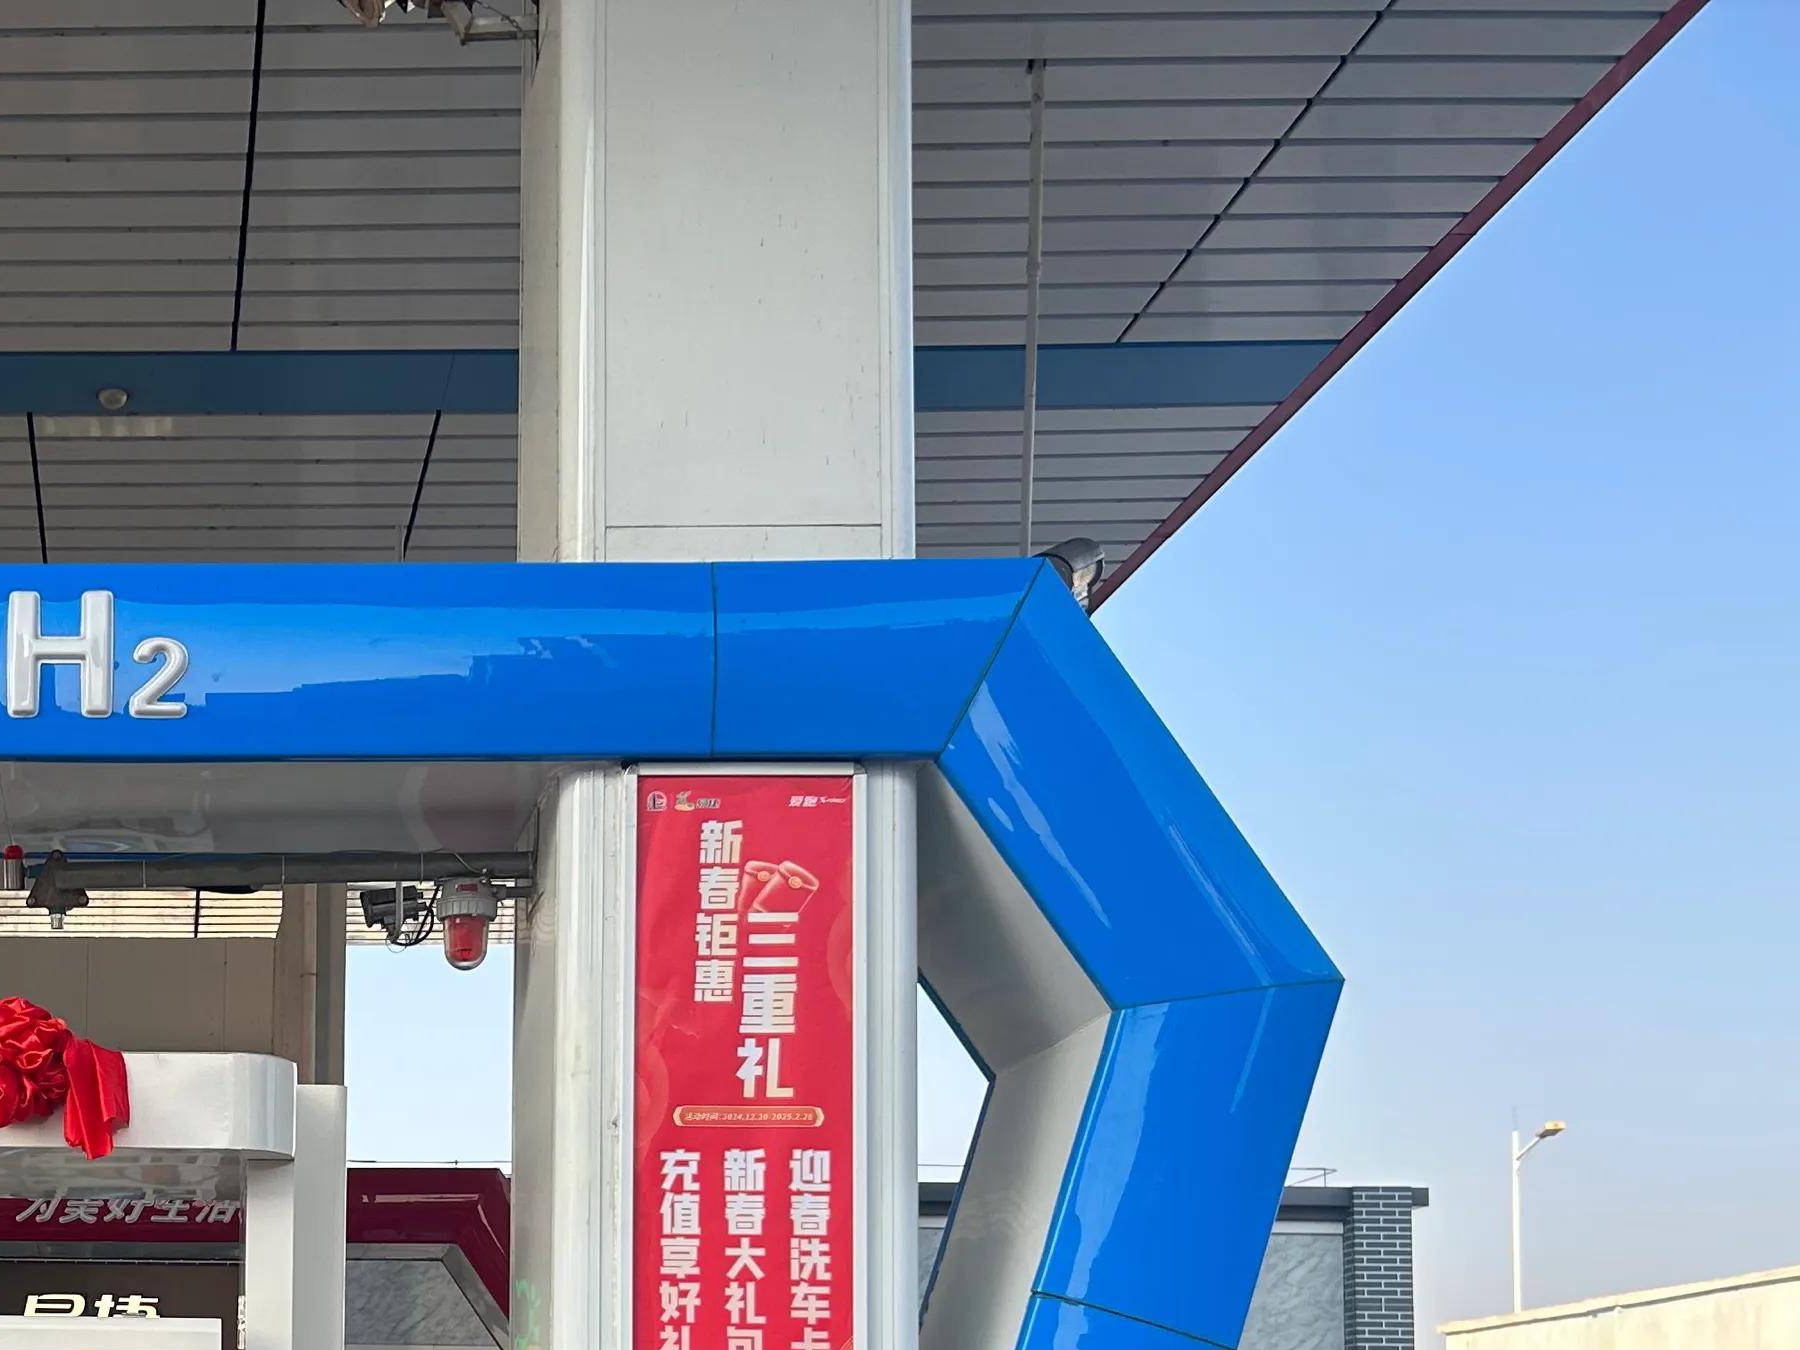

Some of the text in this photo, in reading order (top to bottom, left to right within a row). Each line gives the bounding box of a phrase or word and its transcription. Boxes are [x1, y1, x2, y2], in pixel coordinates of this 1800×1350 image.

[7, 590, 189, 718] H2
[694, 820, 743, 1002] 新春钜惠
[735, 911, 800, 1098] 三重礼
